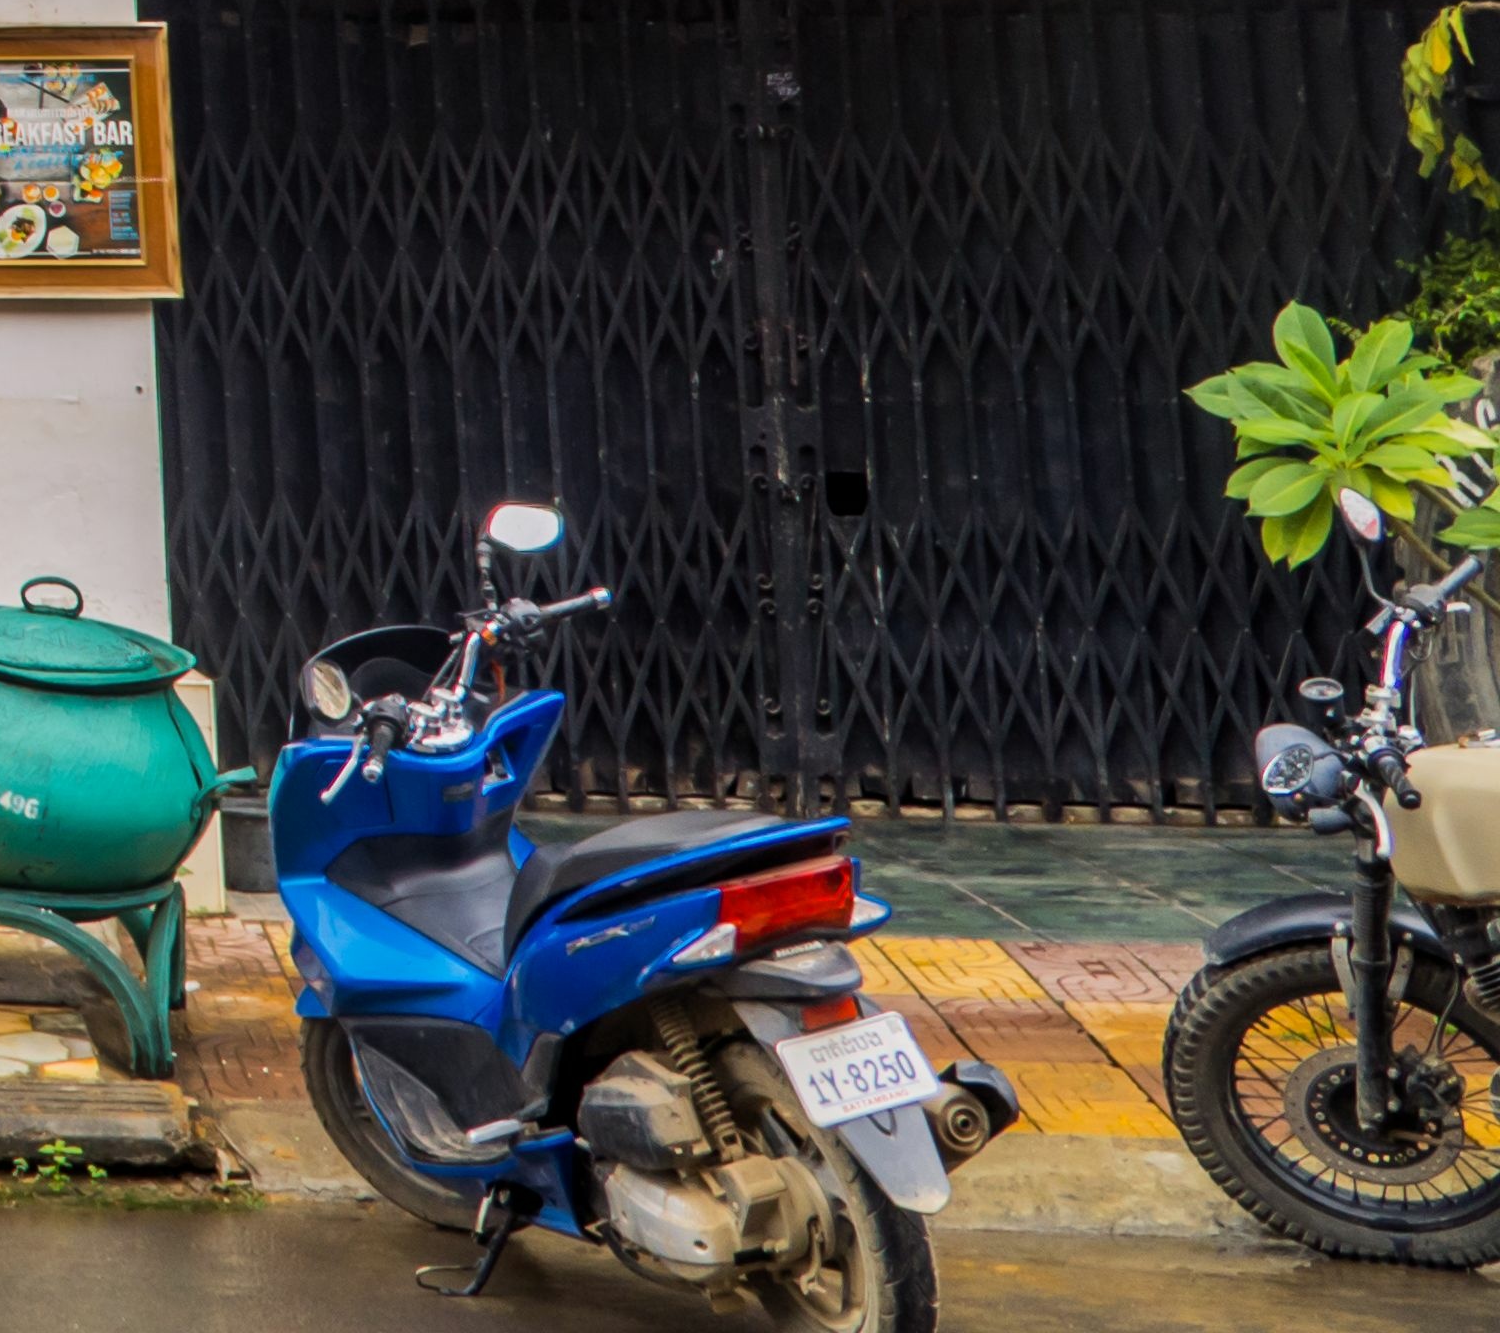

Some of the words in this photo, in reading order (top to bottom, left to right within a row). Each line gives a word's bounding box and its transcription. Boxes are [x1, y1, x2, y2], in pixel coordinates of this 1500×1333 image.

[93, 120, 134, 146] BAR
[775, 939, 823, 958] HONDA
[808, 1049, 917, 1106] 1Y-8250
[842, 1088, 909, 1114] BATTAMBANG
